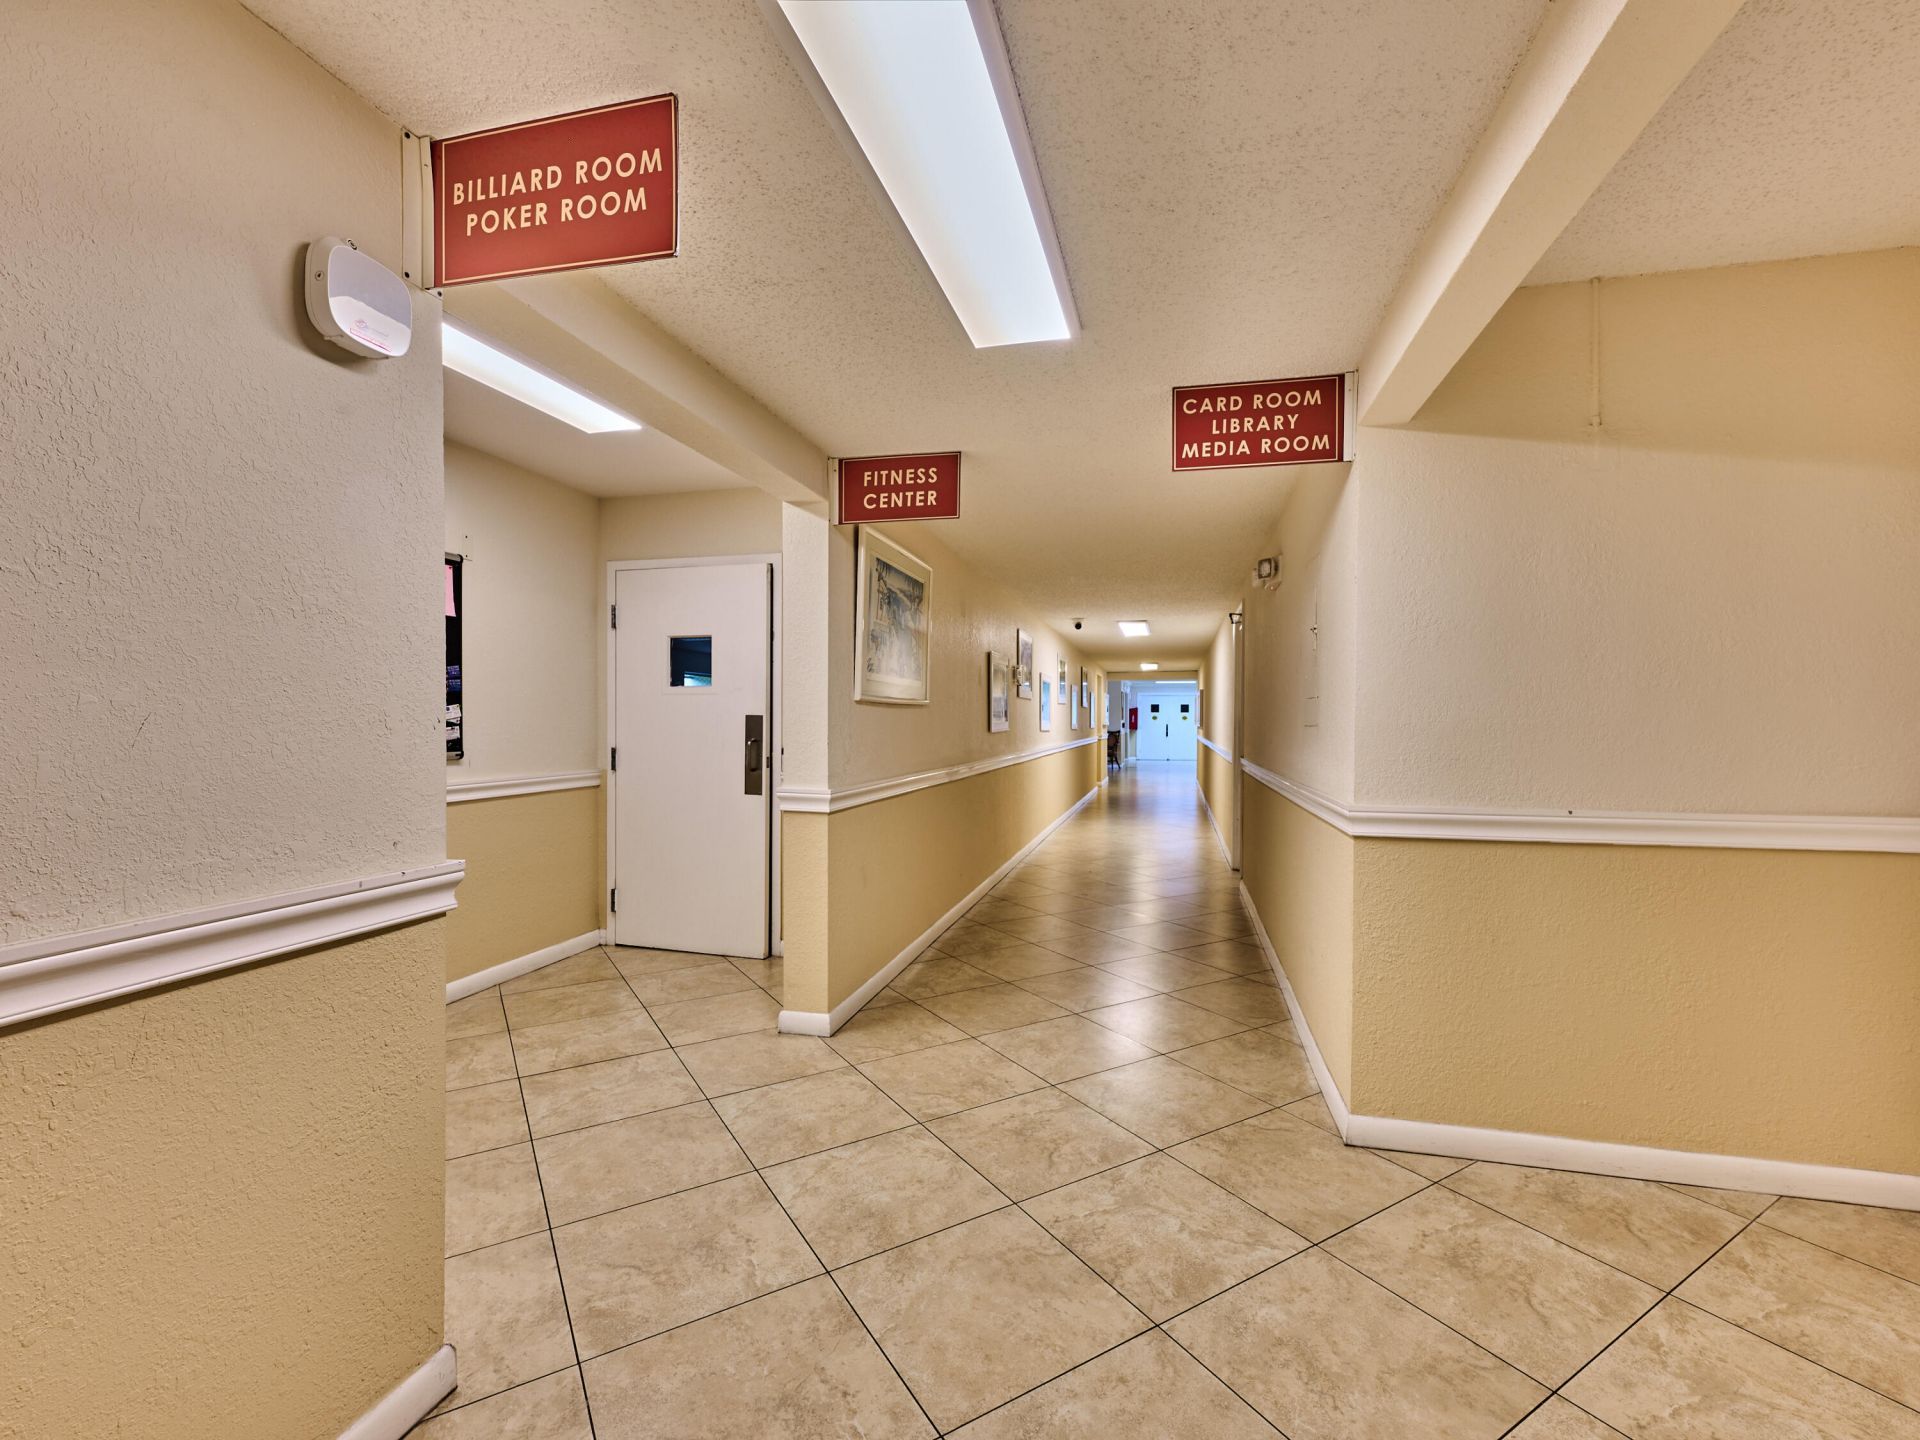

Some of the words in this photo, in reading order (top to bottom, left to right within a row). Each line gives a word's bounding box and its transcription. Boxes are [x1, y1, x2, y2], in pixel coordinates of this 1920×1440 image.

[454, 166, 562, 205] BILLIARD
[576, 148, 662, 184] ROOM
[467, 203, 547, 236] POKER
[561, 187, 646, 222] ROOM
[1183, 396, 1242, 414] CARD
[1254, 390, 1321, 409] ROOM
[1212, 414, 1298, 434] LIBRARY
[1182, 440, 1250, 458] MEDIA
[1261, 435, 1329, 453] ROOM
[864, 468, 937, 486] FITNESS
[864, 491, 936, 509] CENTER
